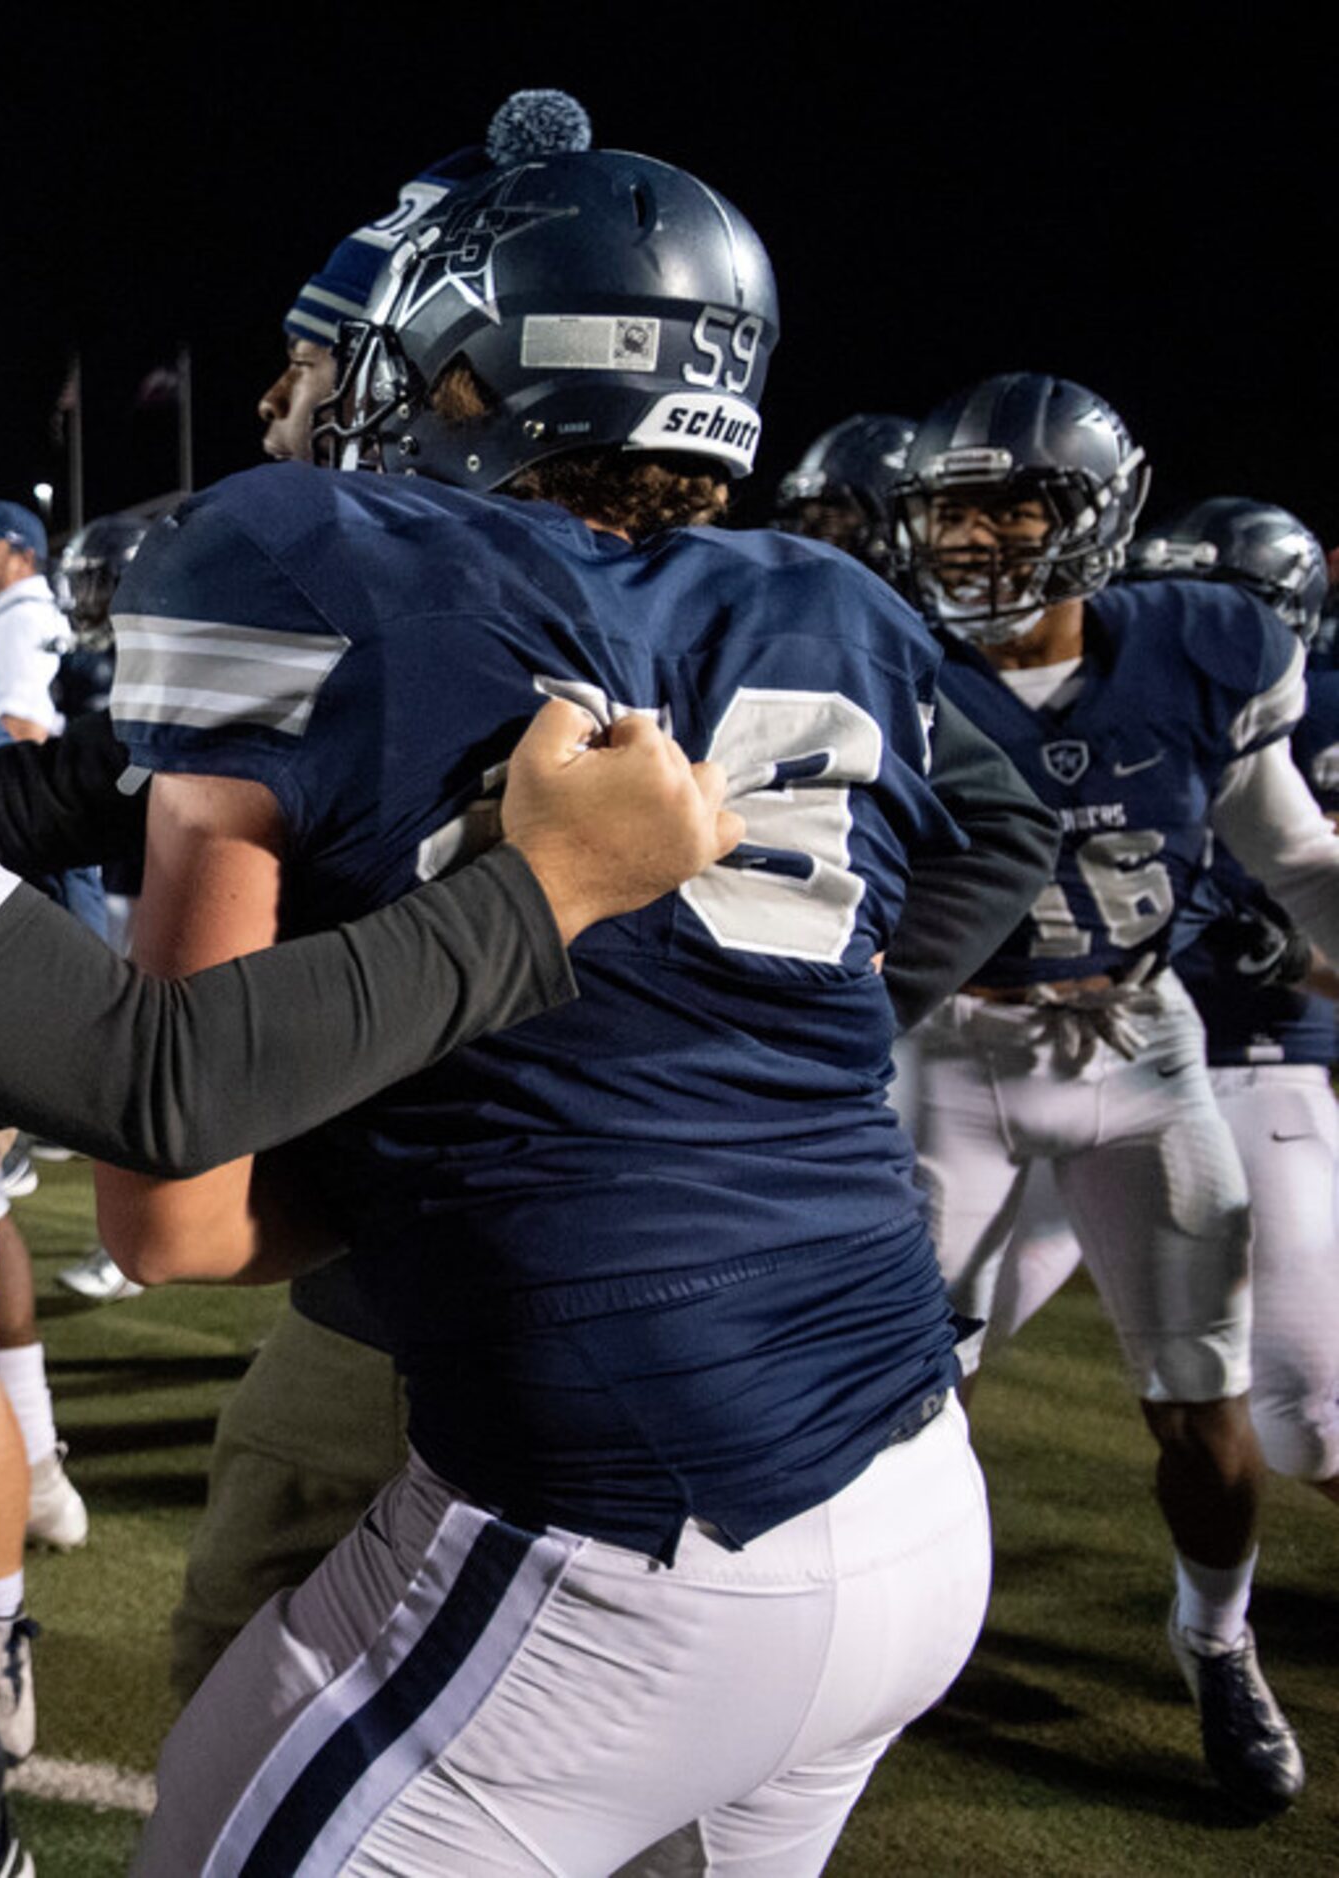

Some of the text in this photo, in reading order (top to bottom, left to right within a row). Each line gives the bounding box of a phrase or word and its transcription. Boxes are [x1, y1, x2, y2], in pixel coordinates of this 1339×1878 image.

[683, 305, 762, 393] 59
[663, 406, 758, 450] schutt
[1029, 830, 1175, 959] 16
